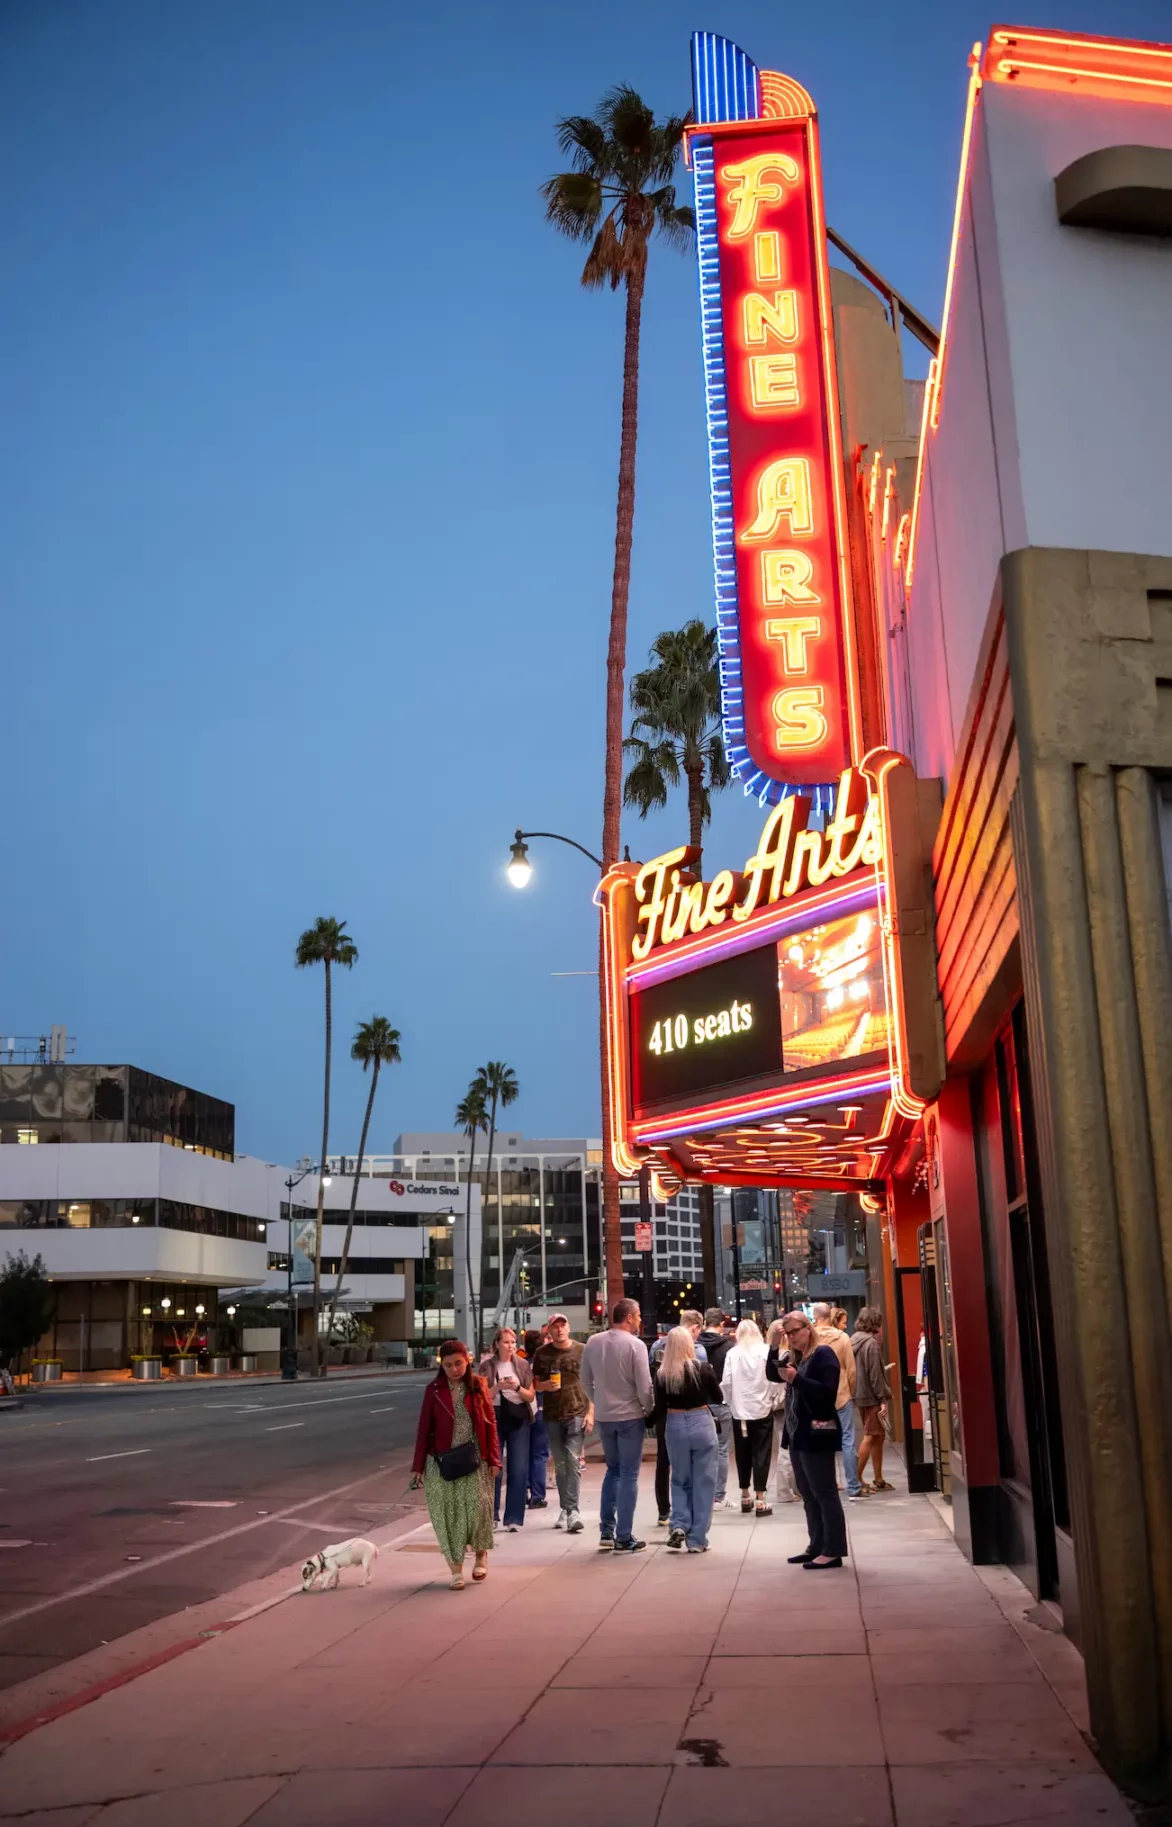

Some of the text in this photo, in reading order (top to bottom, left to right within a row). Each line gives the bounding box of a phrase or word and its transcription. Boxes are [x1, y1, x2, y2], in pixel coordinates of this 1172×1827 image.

[722, 152, 827, 752] FINE ARTS
[631, 768, 883, 959] Fine Arts
[649, 1000, 753, 1055] 410 seats
[407, 1184, 459, 1196] Cedars Sinai
